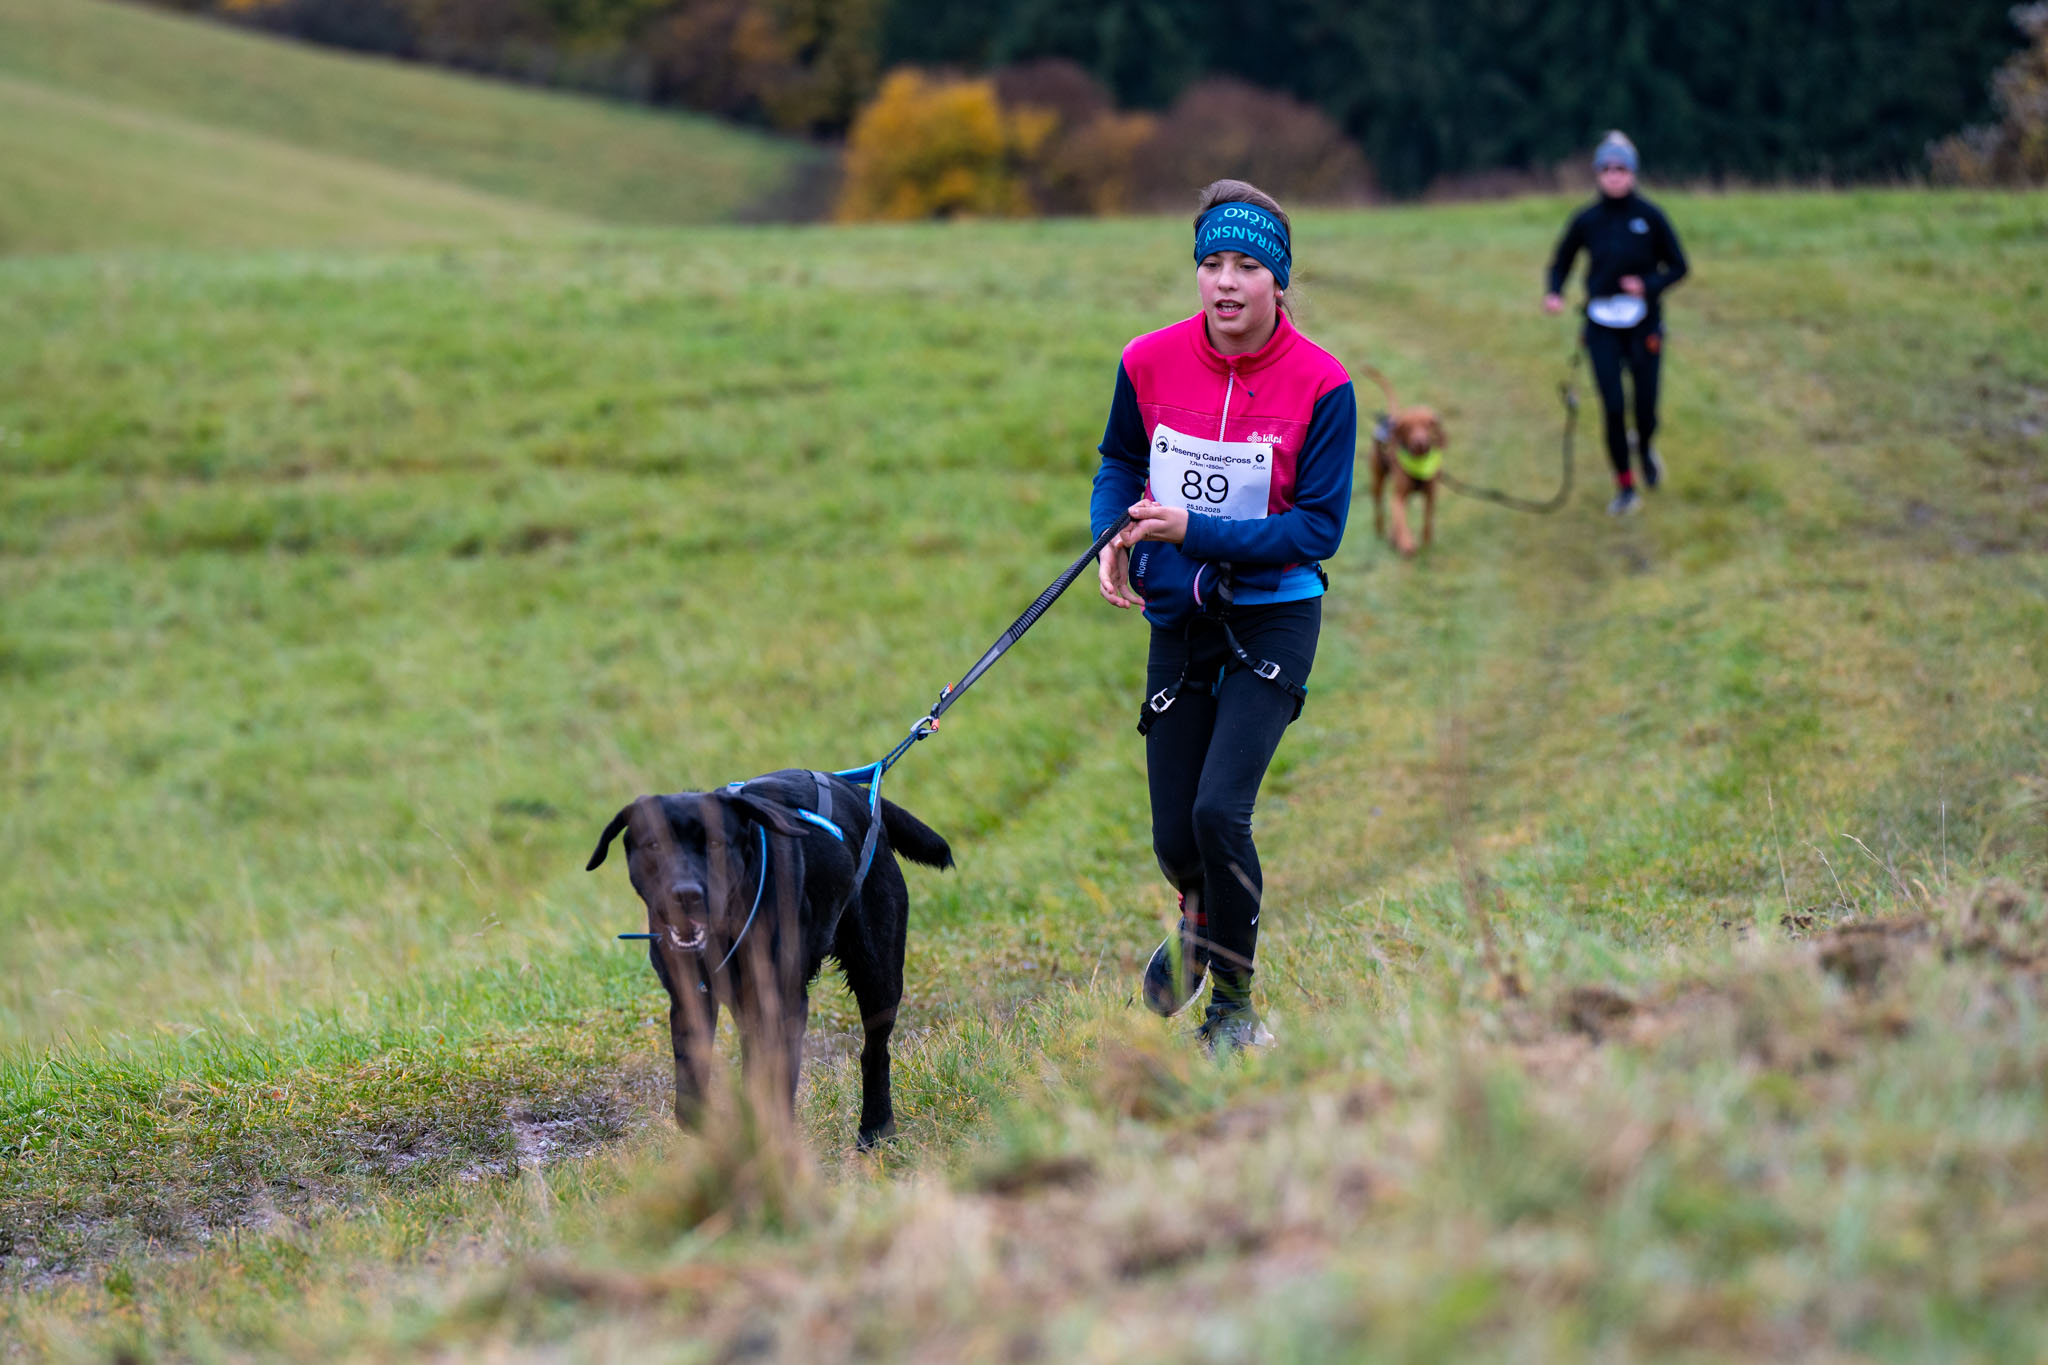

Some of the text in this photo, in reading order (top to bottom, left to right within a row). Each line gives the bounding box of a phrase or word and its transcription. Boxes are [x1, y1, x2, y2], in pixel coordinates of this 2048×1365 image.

[1204, 225, 1284, 262] FATRANSKÝ
[1170, 445, 1252, 465] Jesenný Cani-Cross
[1181, 469, 1229, 504] 89
[1186, 503, 1221, 514] 25.10.2025
[1136, 552, 1149, 578] NORTH
